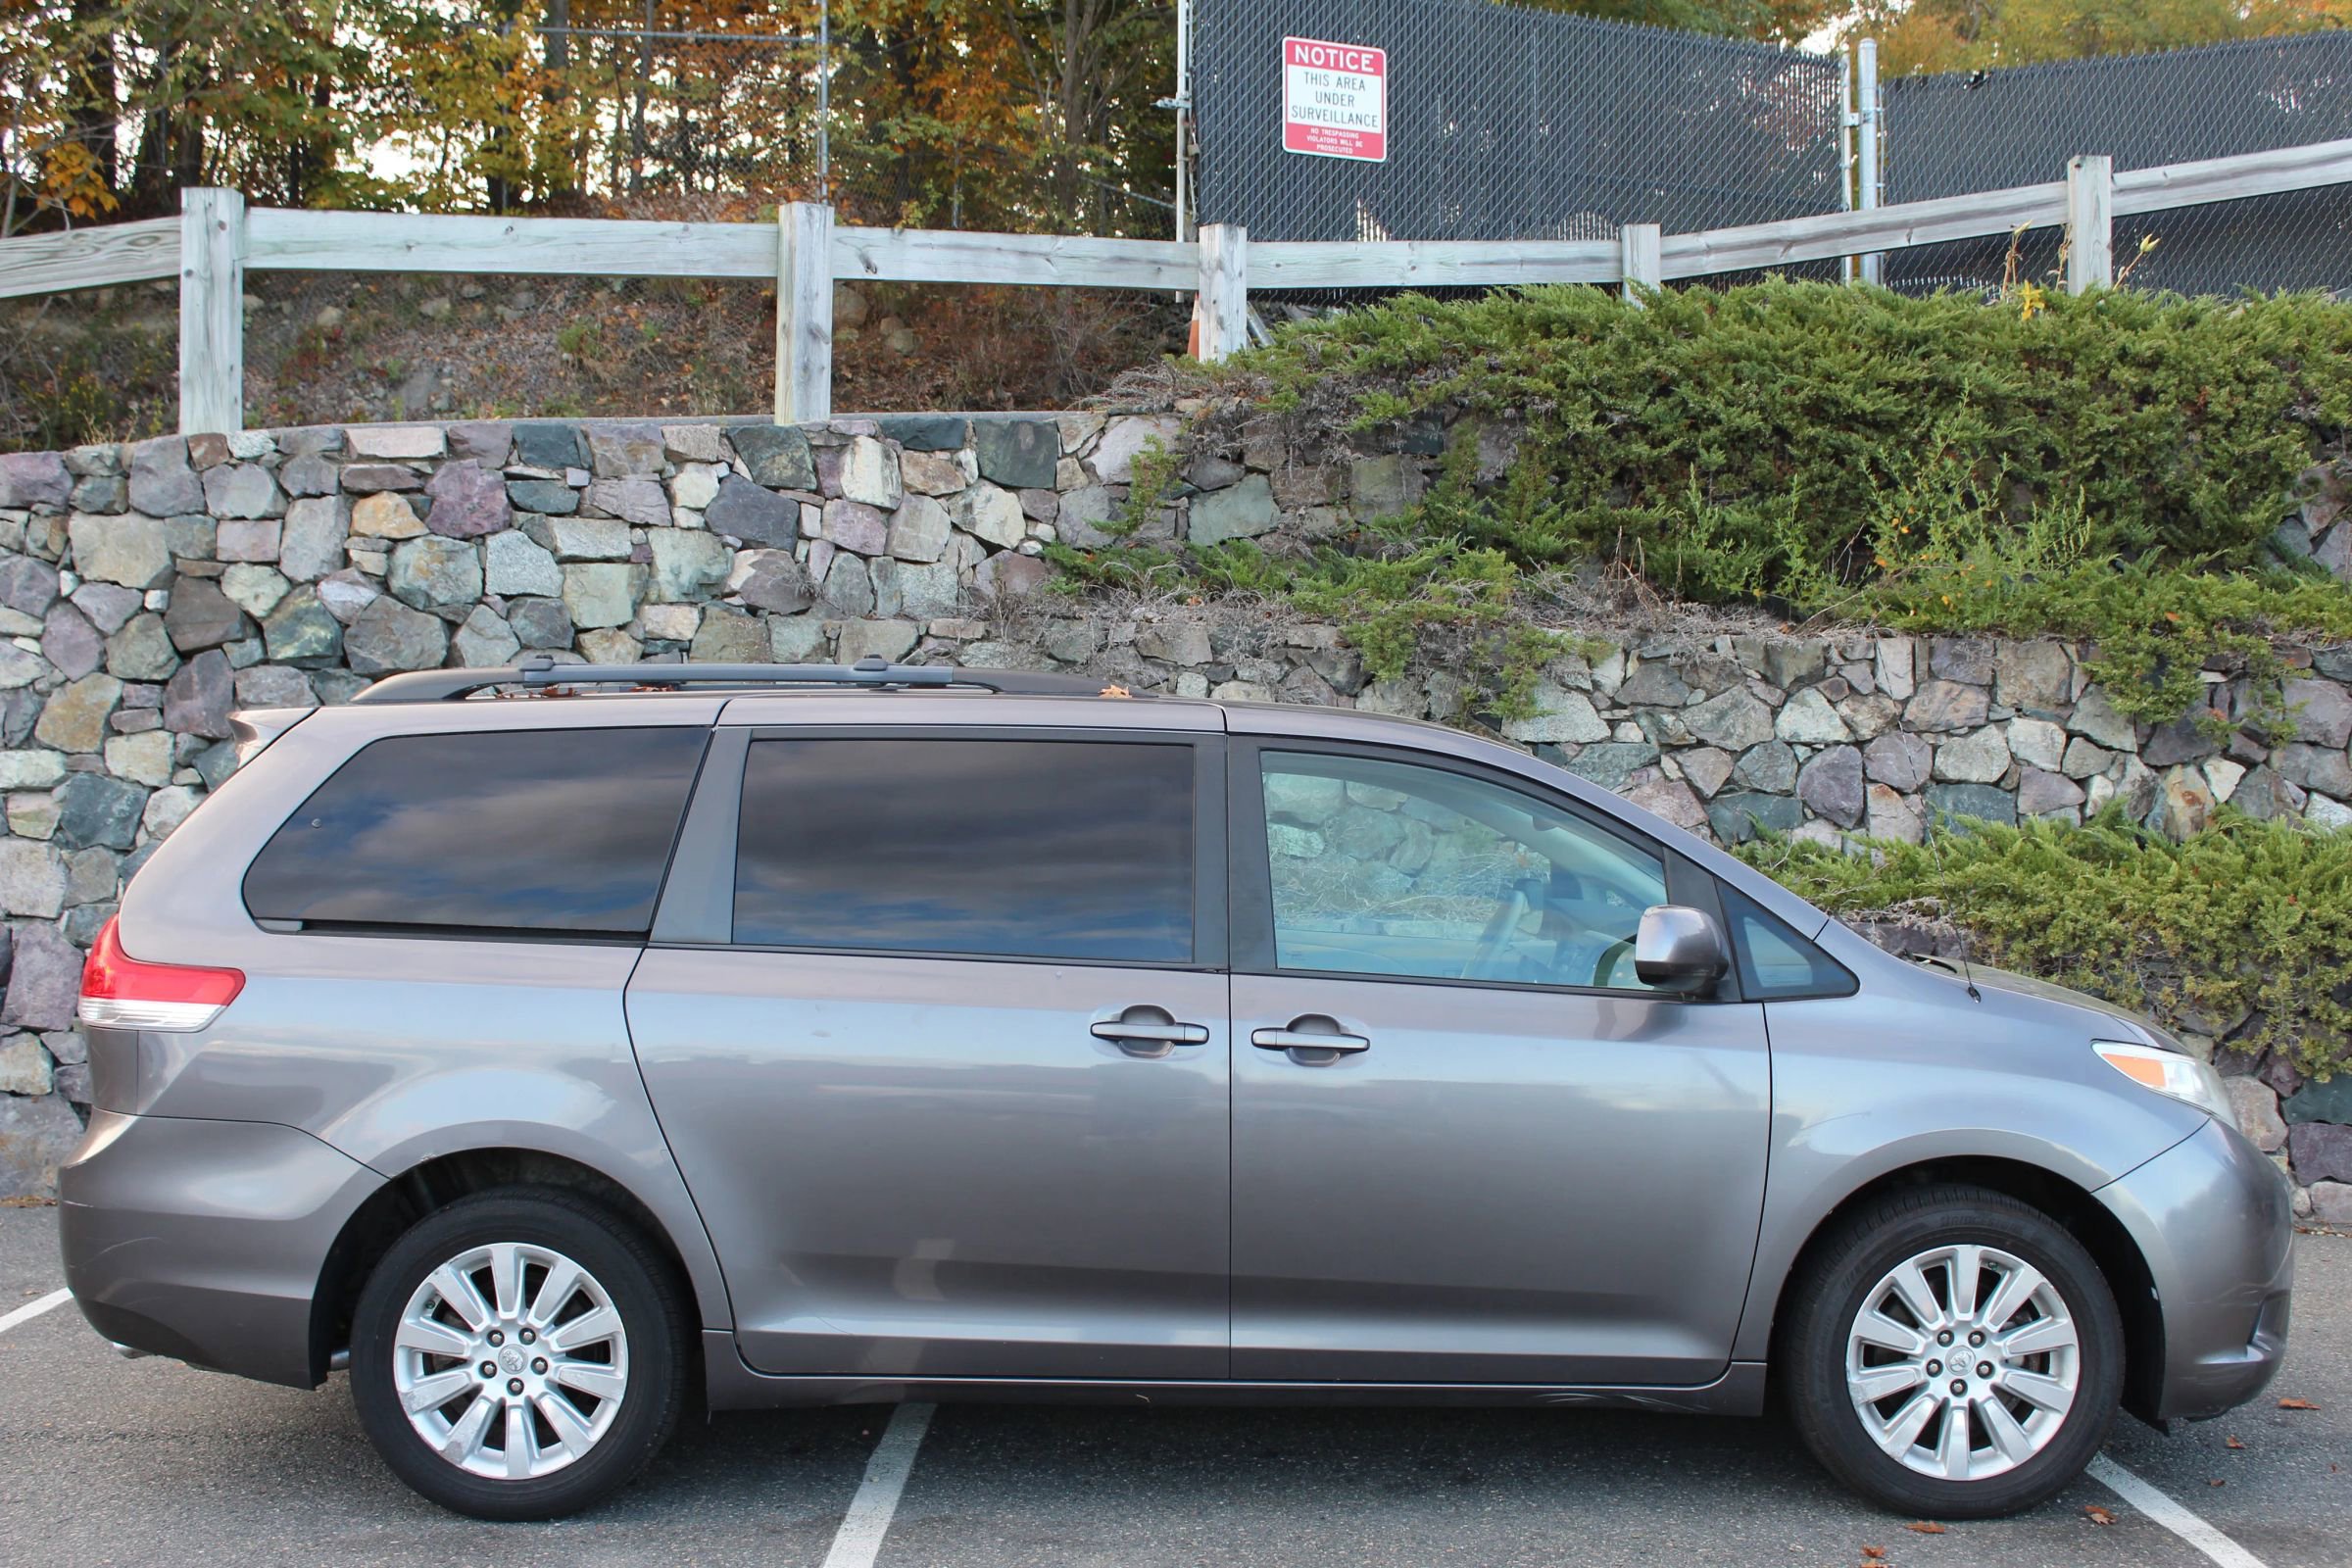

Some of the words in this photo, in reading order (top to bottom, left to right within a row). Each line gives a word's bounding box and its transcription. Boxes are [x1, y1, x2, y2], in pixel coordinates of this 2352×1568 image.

[1295, 44, 1374, 73] NOTICE
[1304, 72, 1330, 87] THIS
[1336, 75, 1365, 91] AREA
[1315, 90, 1355, 107] UNDER
[1292, 105, 1378, 128] SURVEILLANCE
[1306, 135, 1339, 145] VIOLATORS
[1321, 128, 1359, 139] TRESPASSING
[1316, 144, 1353, 154] PROSECUTED
